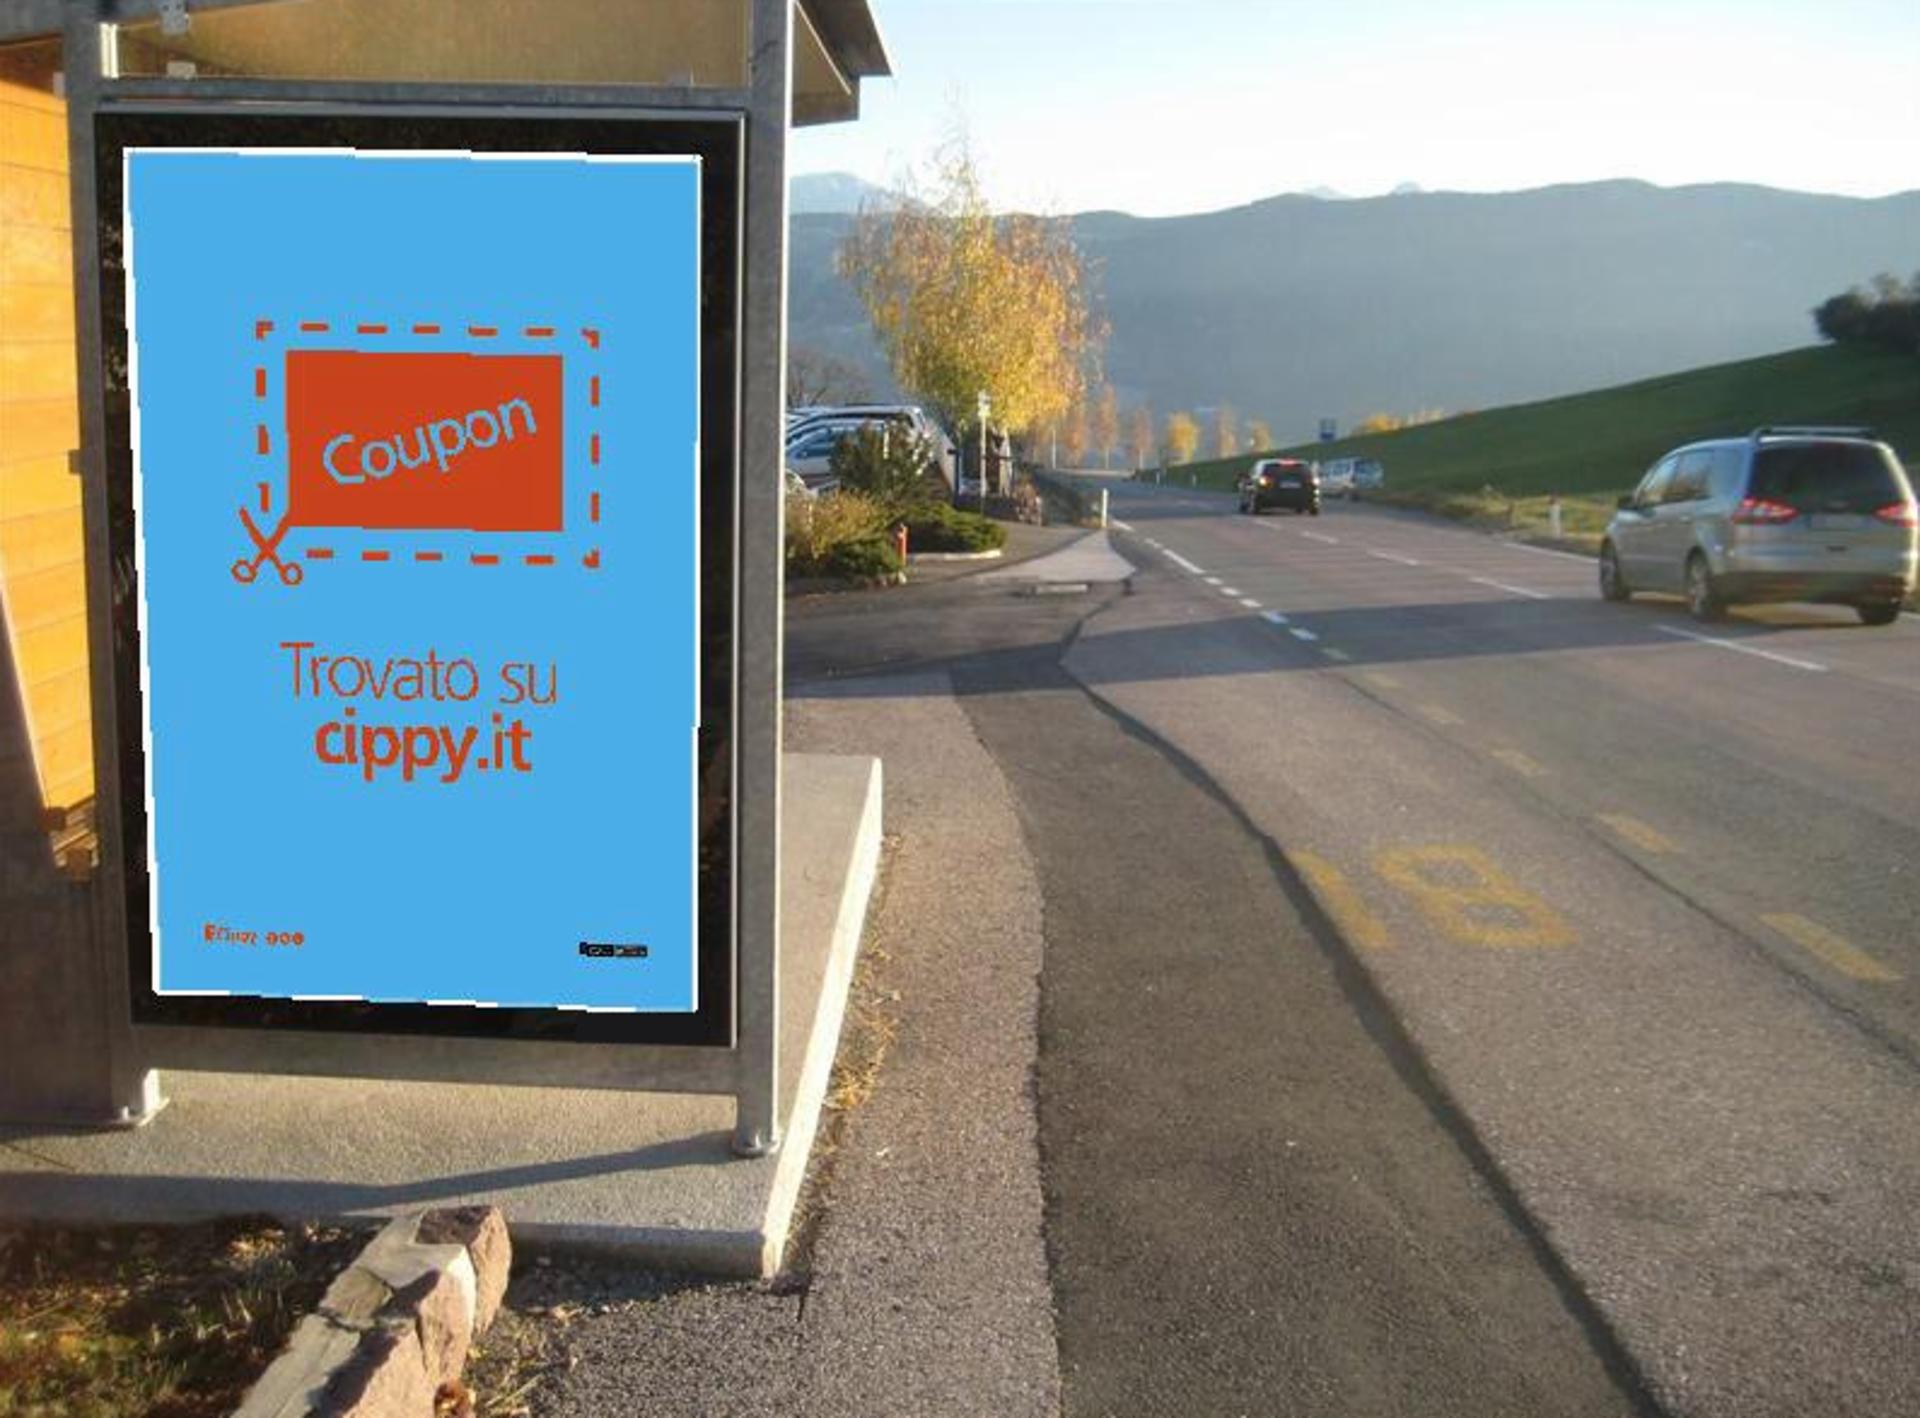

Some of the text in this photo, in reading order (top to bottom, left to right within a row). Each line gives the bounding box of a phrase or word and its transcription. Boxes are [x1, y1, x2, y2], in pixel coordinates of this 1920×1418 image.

[321, 397, 538, 485] Coupon
[279, 641, 558, 706] Trovato su
[313, 706, 533, 784] cippy.it
